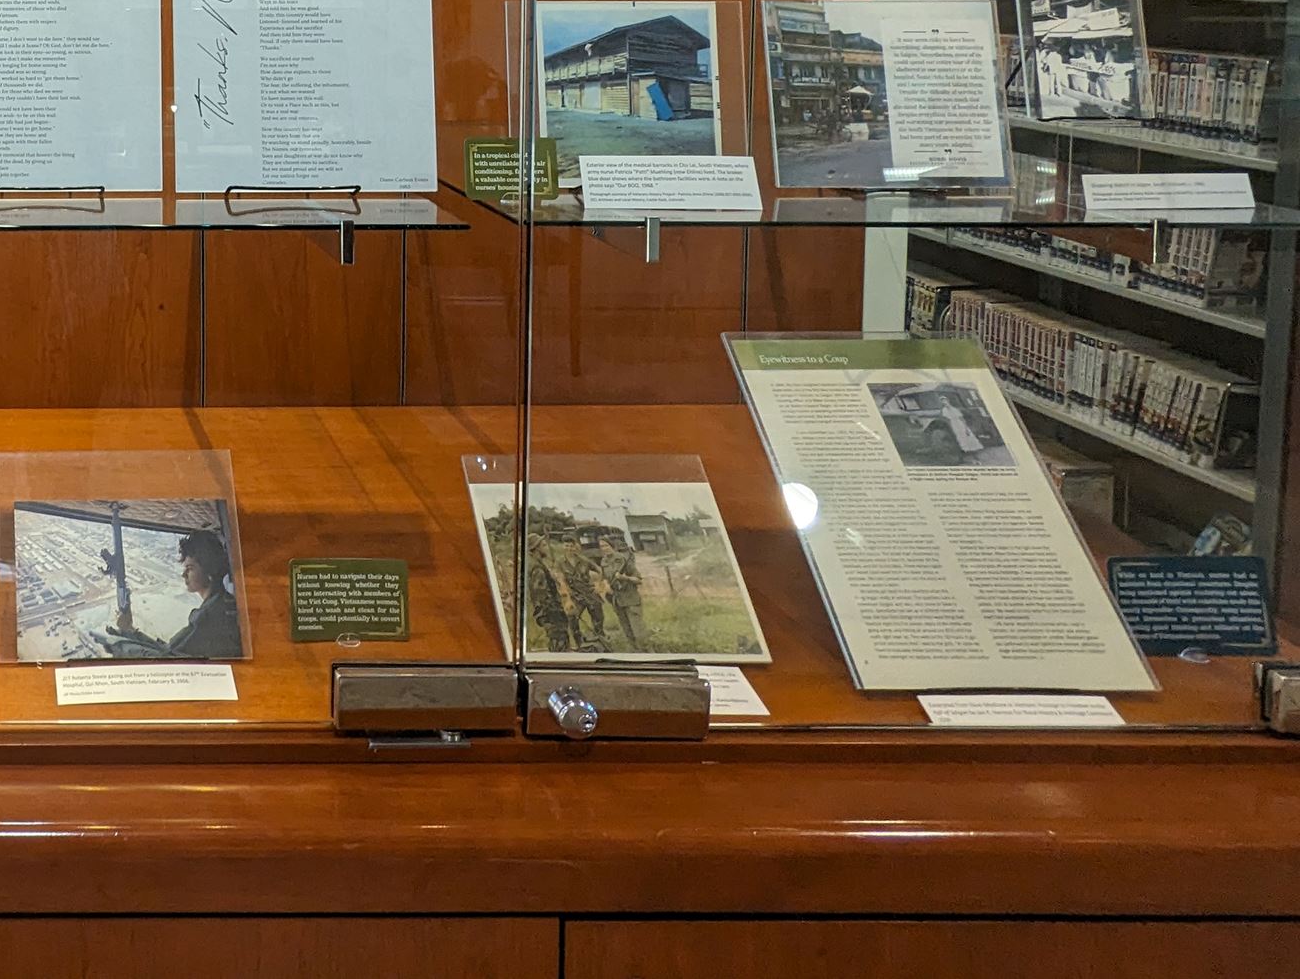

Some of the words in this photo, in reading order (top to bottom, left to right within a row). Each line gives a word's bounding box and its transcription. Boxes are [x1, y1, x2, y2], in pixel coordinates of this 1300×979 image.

[486, 152, 510, 160] tropical
[474, 168, 514, 176] conditioning,
[759, 354, 806, 365] Eyewitness
[806, 356, 816, 364] to
[823, 354, 849, 365] Coup
[340, 573, 366, 581] navigate
[384, 573, 399, 581] days
[337, 615, 370, 623] potentially
